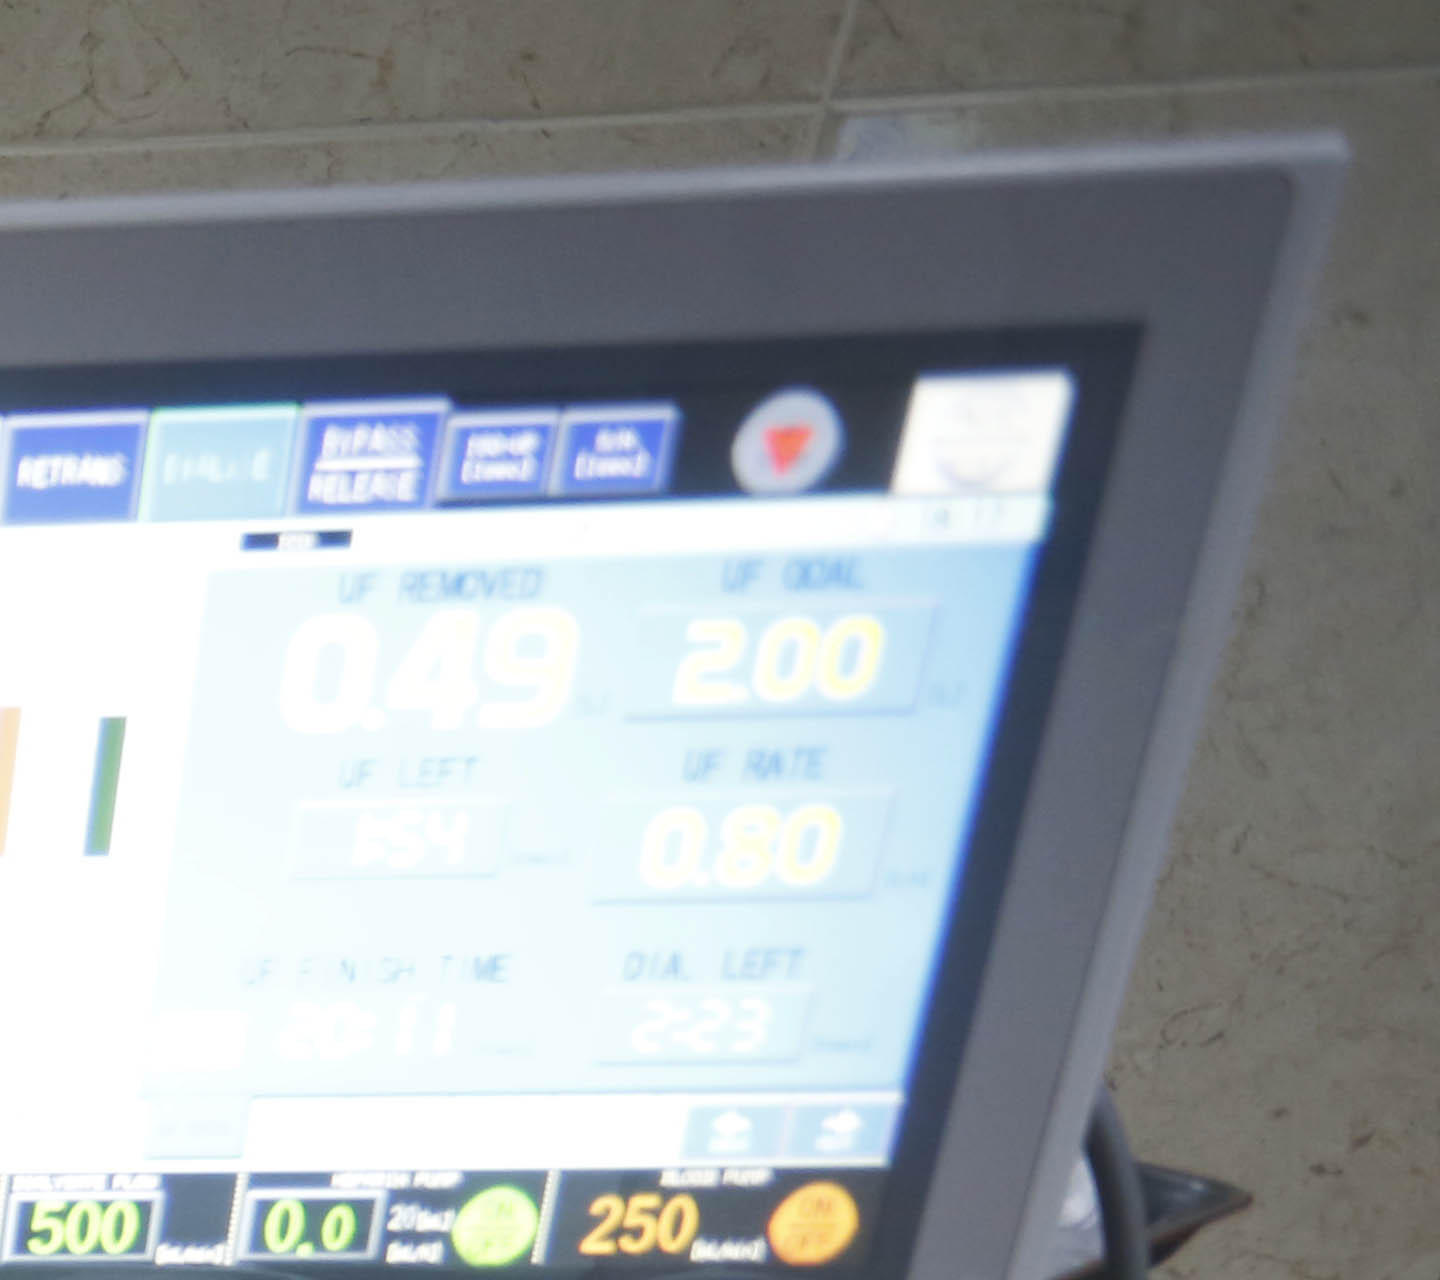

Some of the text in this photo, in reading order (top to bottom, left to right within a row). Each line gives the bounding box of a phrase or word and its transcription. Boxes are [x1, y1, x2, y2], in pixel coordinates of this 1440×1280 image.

[308, 471, 419, 504] RELEASE
[337, 567, 547, 604] UF REMOVED
[721, 559, 763, 592] UF
[279, 606, 579, 734] 0.49
[671, 615, 885, 705] 2.00
[397, 754, 481, 787] LEFT
[684, 746, 829, 782] UF RATE
[638, 805, 844, 891] 0.80
[721, 947, 807, 980] LEFT
[27, 1200, 140, 1255] 500
[264, 1198, 356, 1256] 0.0
[580, 1193, 699, 1255] 250
